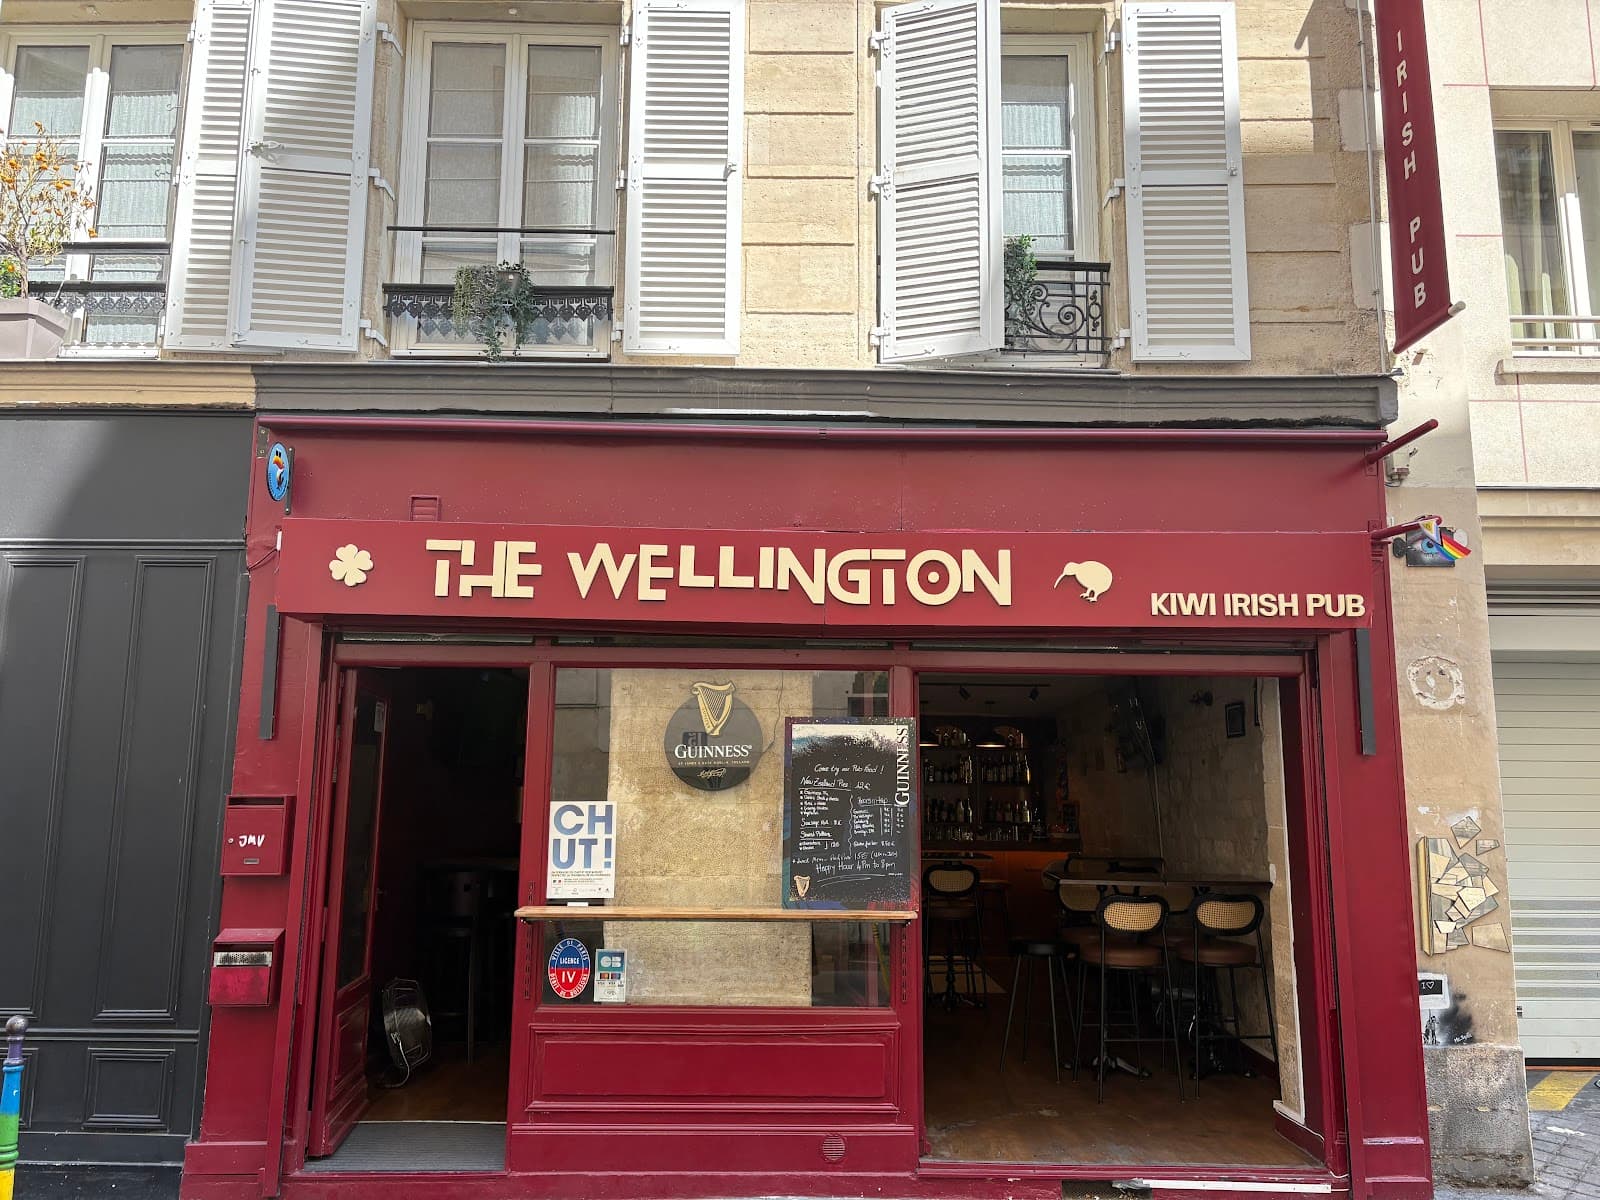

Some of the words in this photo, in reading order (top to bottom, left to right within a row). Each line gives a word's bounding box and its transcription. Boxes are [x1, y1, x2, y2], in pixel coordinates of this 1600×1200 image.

[1396, 29, 1417, 181] IRISH
[1408, 215, 1428, 310] PUB
[425, 539, 543, 599] THE
[567, 541, 1012, 606] WELLINGTON
[1150, 592, 1217, 616] KIWI
[1223, 592, 1299, 617] IRISH
[1305, 593, 1366, 617] PUB
[674, 744, 749, 759] GUINNESS
[895, 724, 910, 806] GUINNESS
[800, 776, 813, 786] New
[553, 804, 613, 836] CH
[238, 834, 265, 847] JMV
[552, 838, 613, 870] UT!
[551, 945, 564, 961] VILLE
[577, 944, 590, 961] PARIS
[559, 957, 580, 965] LICENCE
[561, 970, 576, 983] IV
